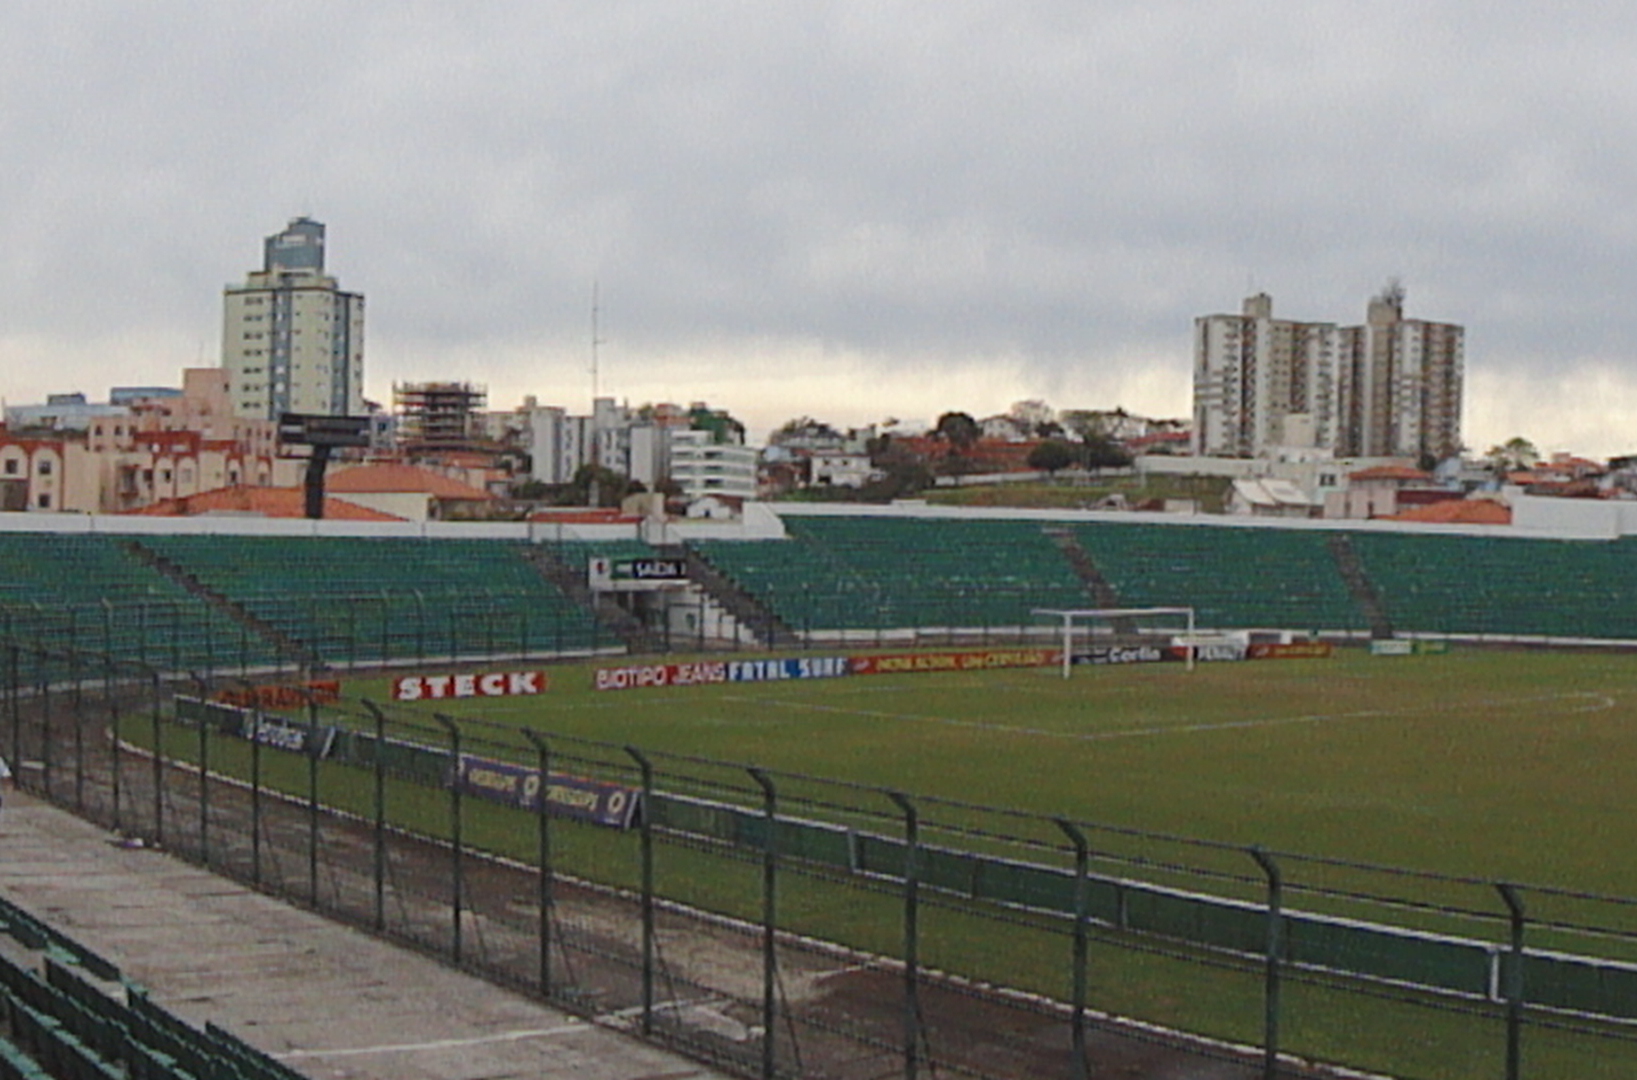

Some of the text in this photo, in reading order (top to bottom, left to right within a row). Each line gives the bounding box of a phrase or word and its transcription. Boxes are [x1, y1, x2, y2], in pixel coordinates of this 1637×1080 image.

[596, 661, 726, 689] BIOTIPO JEANS
[728, 658, 790, 681] FATAL
[800, 657, 846, 679] SURF
[399, 672, 538, 699] STECK
